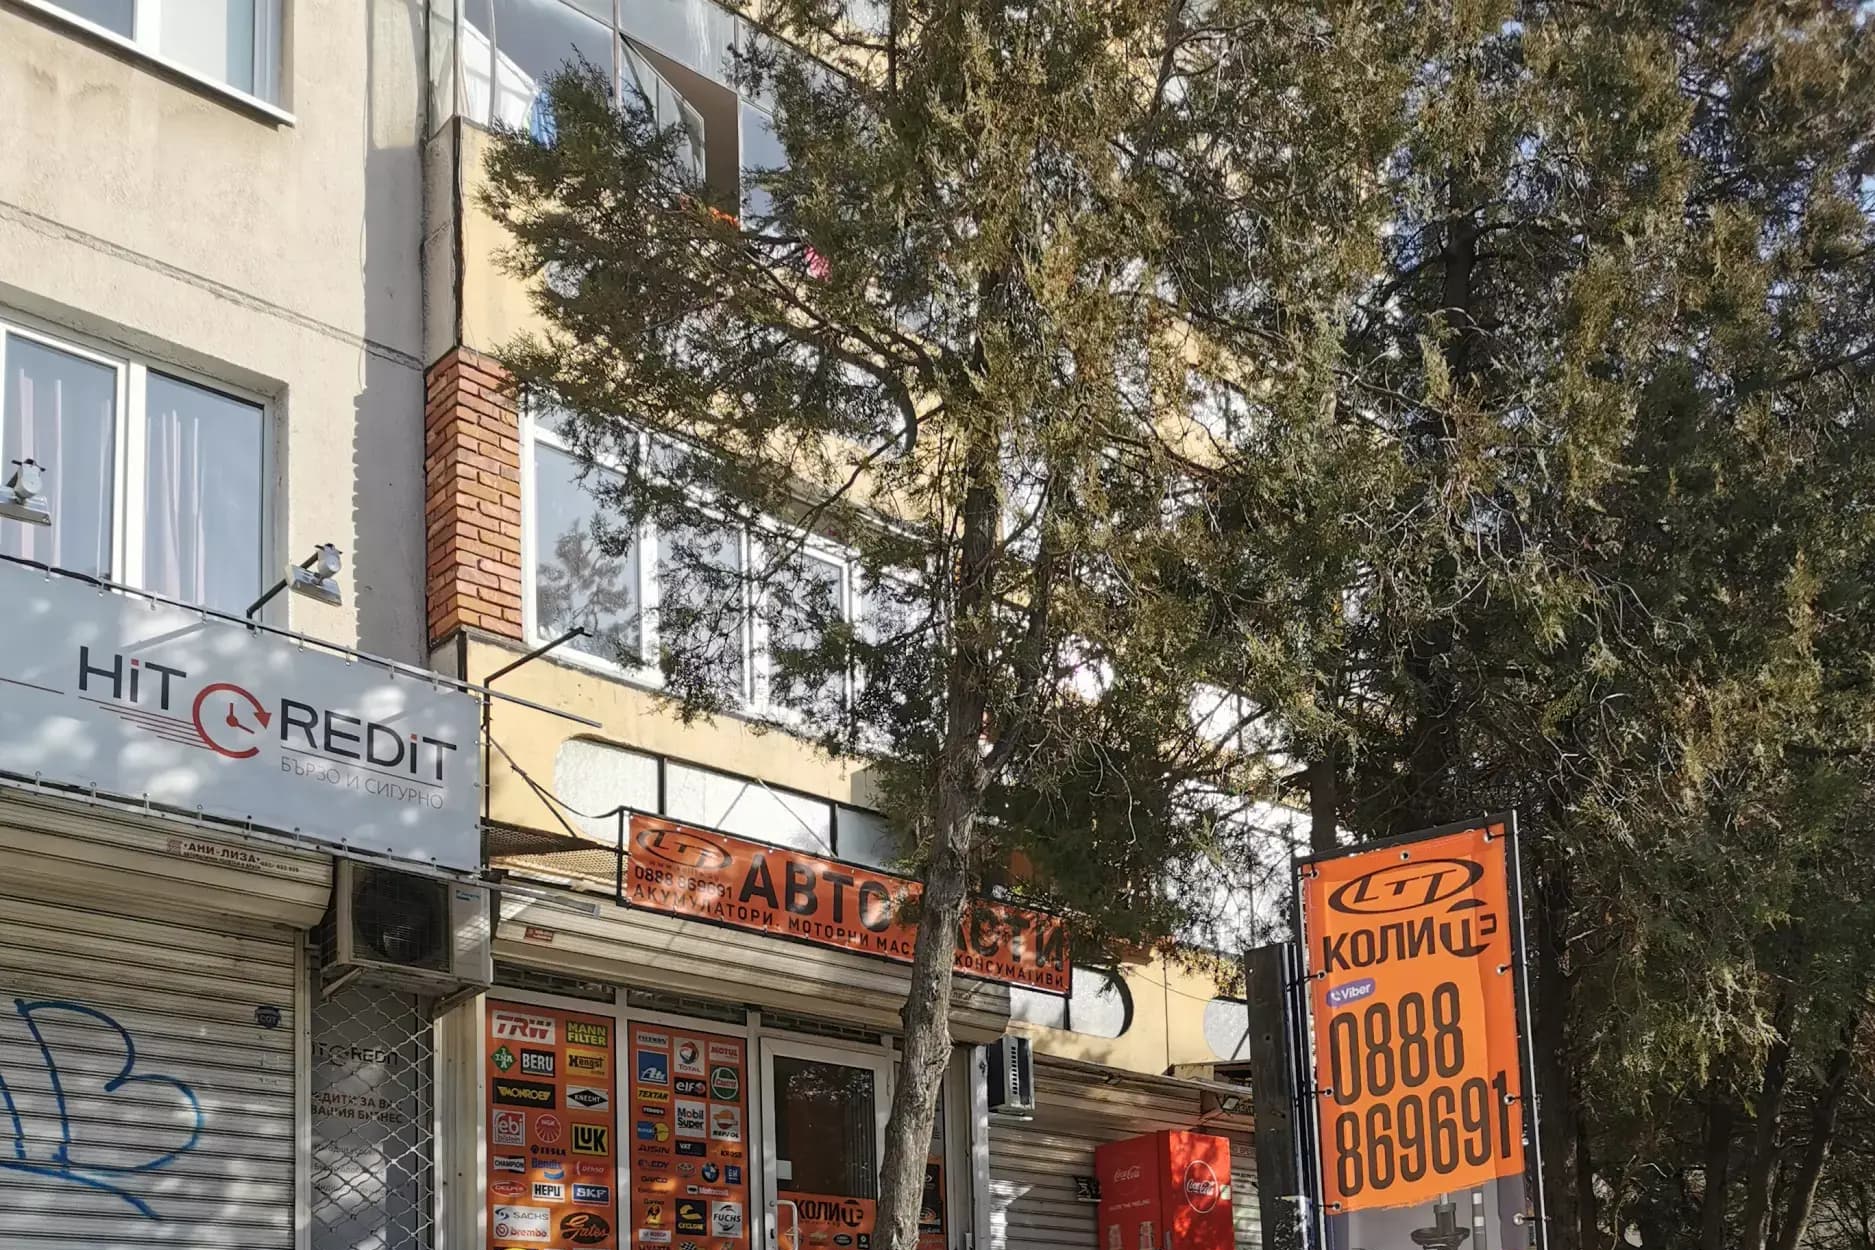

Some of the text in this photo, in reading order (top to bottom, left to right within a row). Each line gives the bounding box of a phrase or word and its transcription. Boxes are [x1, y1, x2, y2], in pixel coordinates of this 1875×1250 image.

[281, 756, 444, 810] БЪРЗО И СИГУРНО
[635, 865, 674, 887] 0888
[676, 874, 733, 899] 869691
[738, 853, 891, 933] АВТО
[788, 917, 869, 946] МОТОРНИ
[1341, 983, 1372, 999] Viber
[496, 1014, 550, 1040] TRW
[567, 1022, 607, 1036] MANN
[567, 1031, 607, 1046] FILTER
[1329, 981, 1465, 1106] 0888
[522, 1053, 554, 1072] BERU
[678, 1063, 702, 1073] TOTAL
[675, 1081, 696, 1093] elf
[574, 1094, 601, 1104] KNECHT
[638, 1090, 668, 1100] TEXTAR
[677, 1107, 705, 1120] Mobil
[677, 1116, 705, 1129] Super
[1335, 1070, 1513, 1197] 869691
[534, 1183, 561, 1197] HEPU
[576, 1187, 608, 1199] SKF
[512, 1211, 549, 1221] SACHS
[713, 1212, 742, 1223] FUCHS
[510, 1226, 548, 1238] brembo
